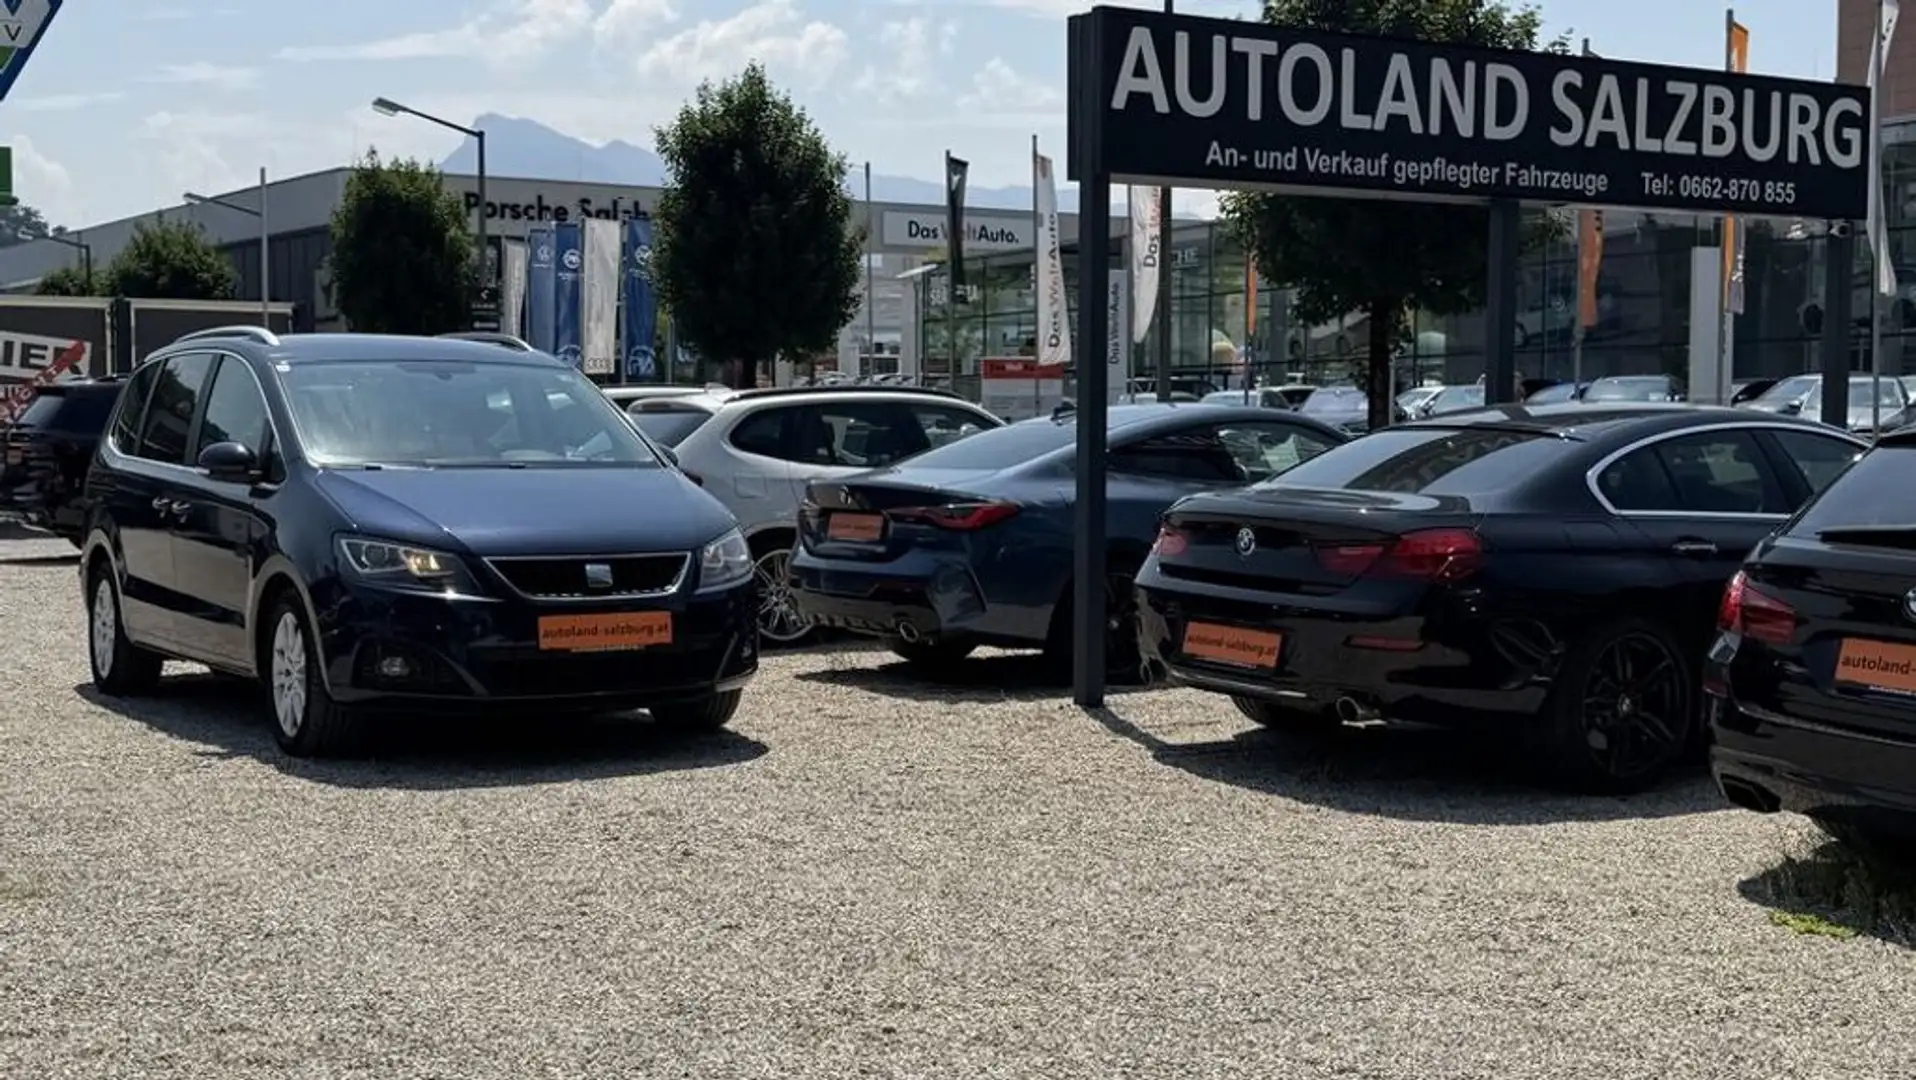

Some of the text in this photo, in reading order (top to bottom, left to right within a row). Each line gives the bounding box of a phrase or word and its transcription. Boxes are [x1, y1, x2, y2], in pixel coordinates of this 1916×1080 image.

[1110, 25, 1863, 169] AUTOLAND SALZBURG
[1205, 140, 1796, 204] An- und Verkauf gepflegter Fahrzeuge Tel: 0662-870 855
[463, 192, 569, 222] Porsche
[1141, 233, 1160, 269] Das
